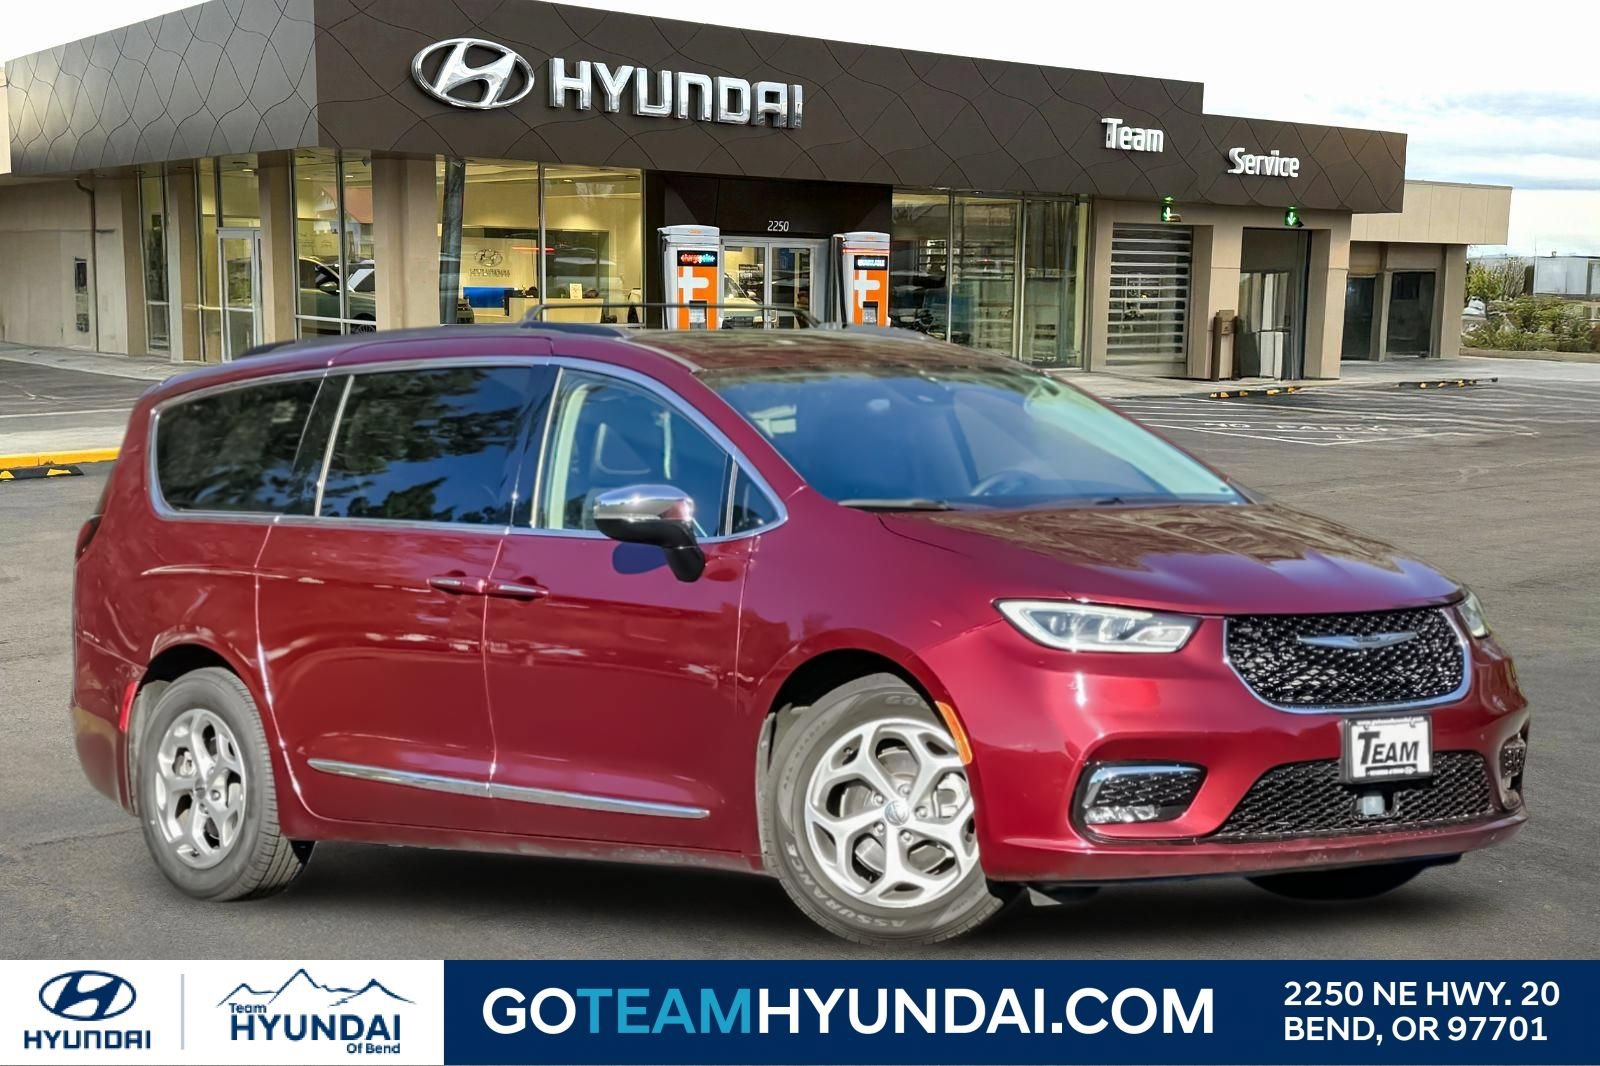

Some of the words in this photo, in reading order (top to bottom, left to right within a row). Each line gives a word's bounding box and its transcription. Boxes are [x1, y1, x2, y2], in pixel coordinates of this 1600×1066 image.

[549, 57, 803, 129] HYUNDAI
[1100, 117, 1164, 153] Team
[1227, 147, 1300, 178] Service
[767, 220, 790, 232] 2250
[785, 842, 907, 928] ASSURANCE
